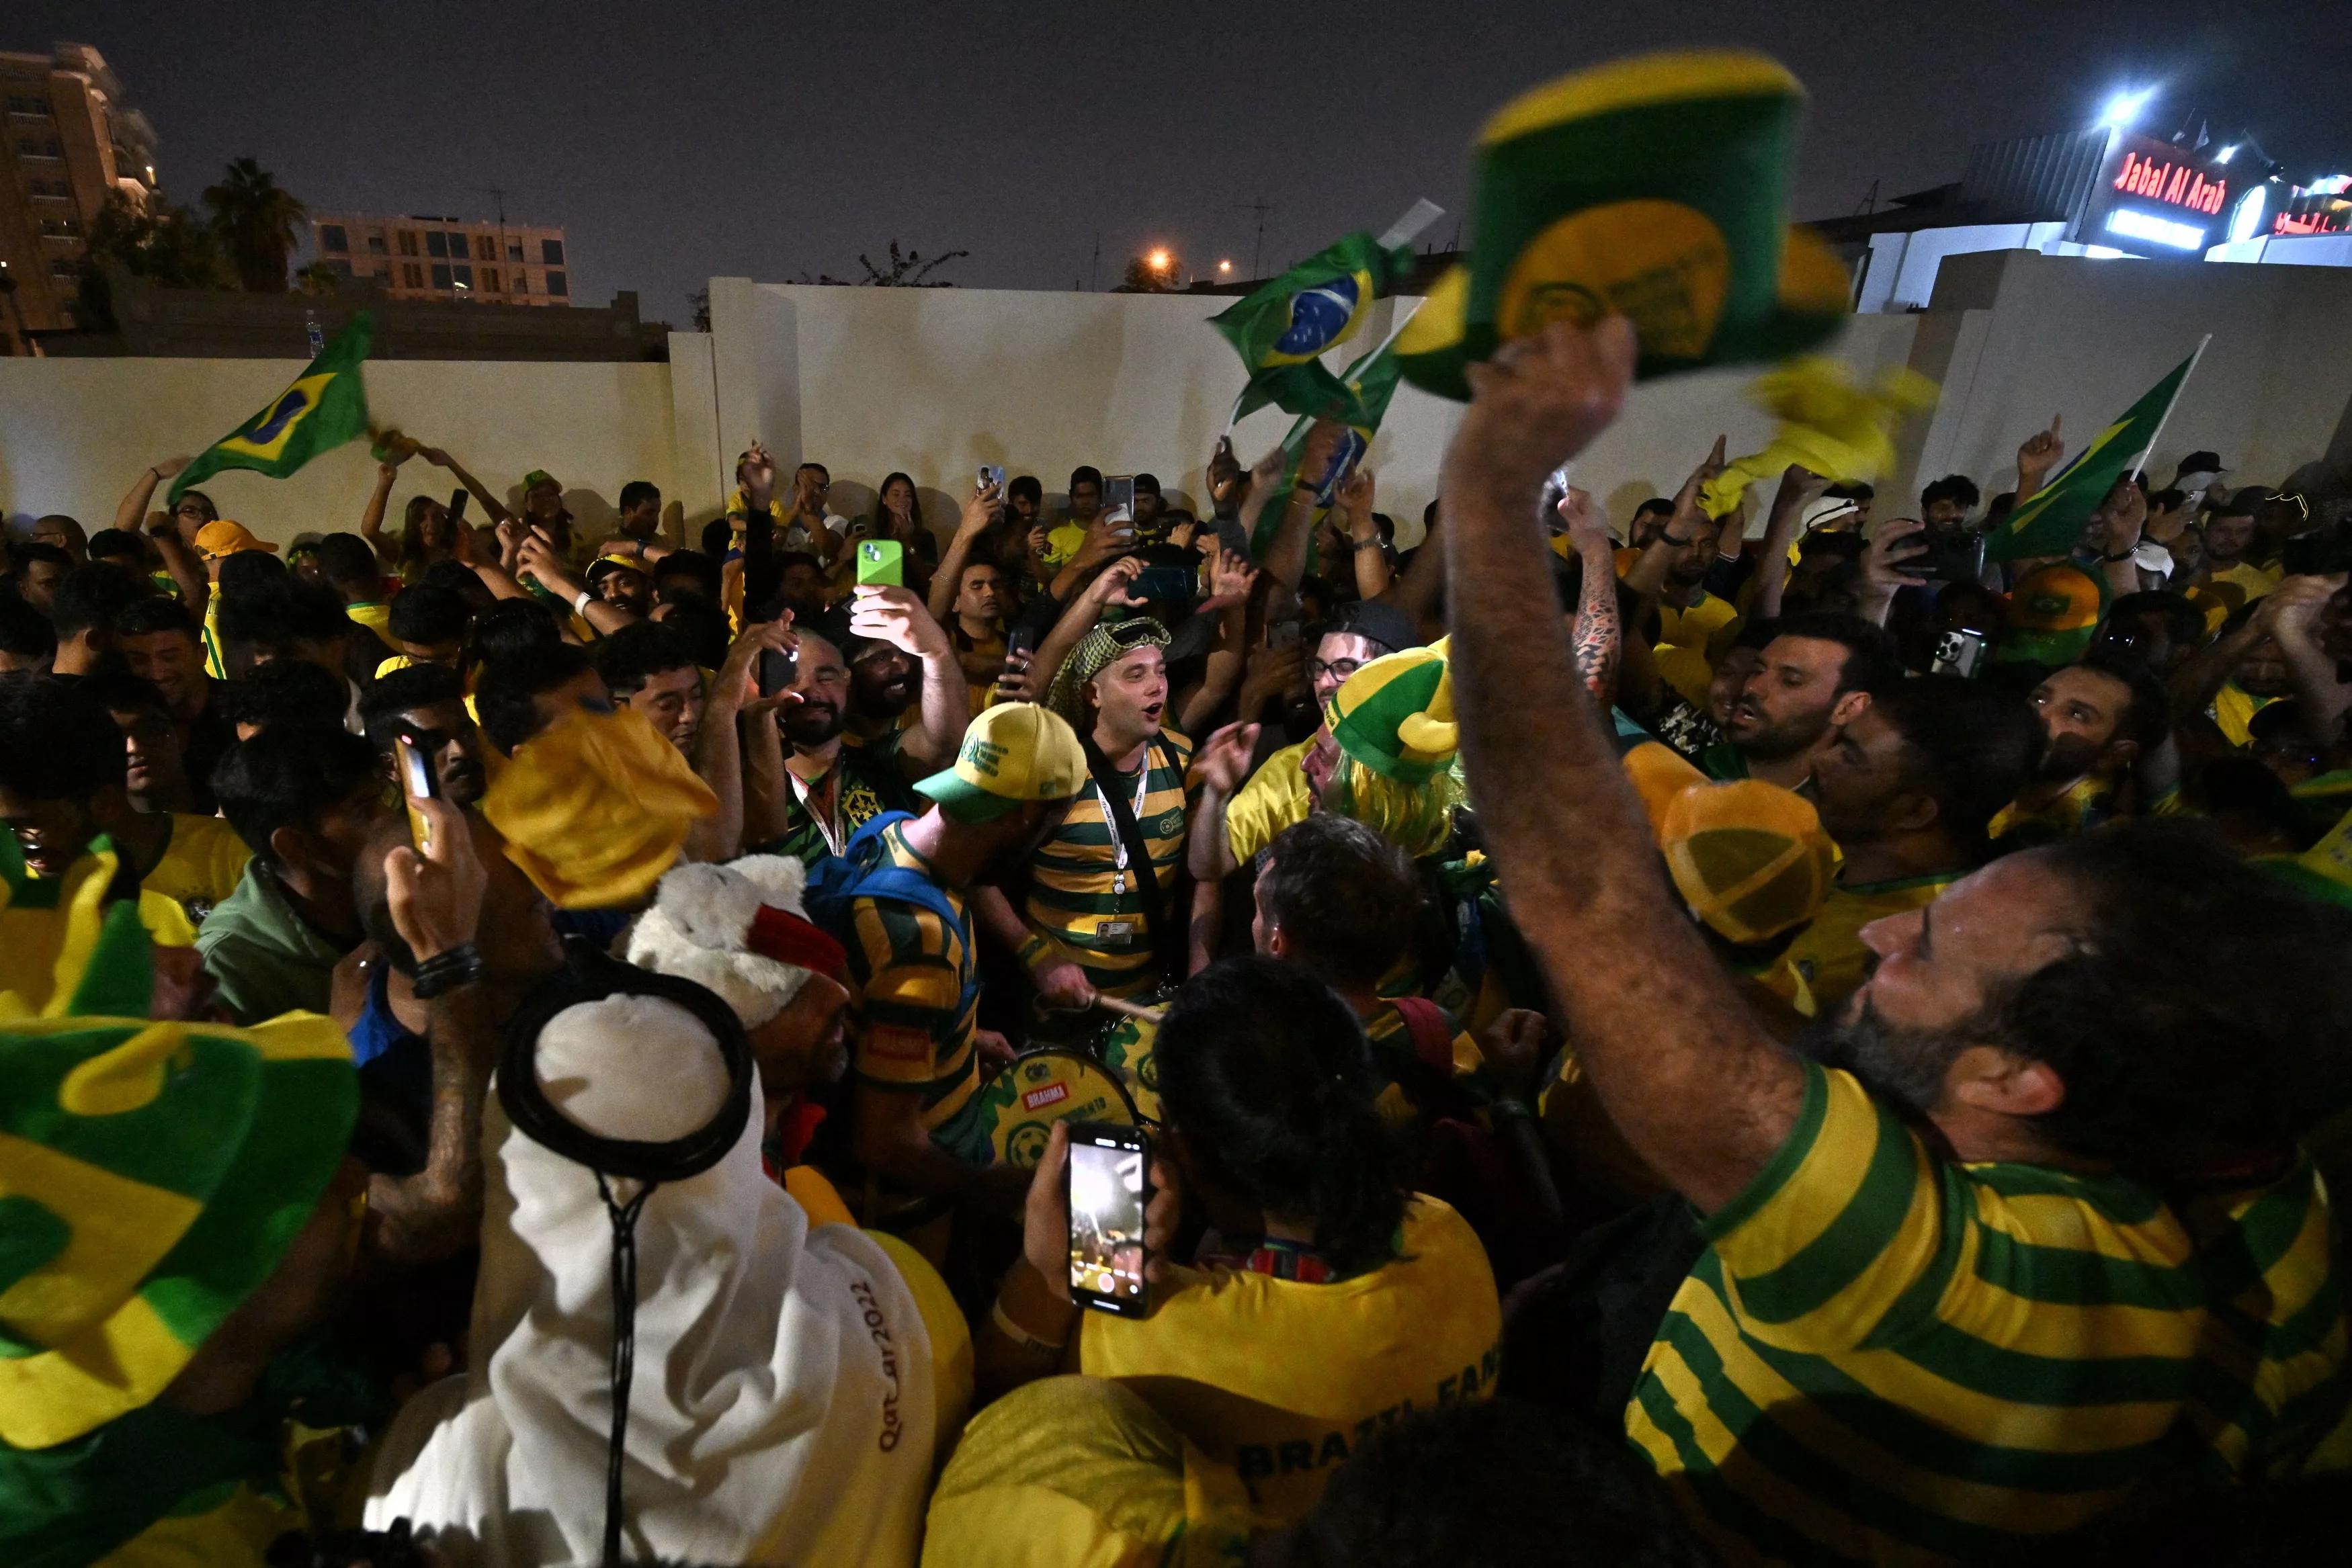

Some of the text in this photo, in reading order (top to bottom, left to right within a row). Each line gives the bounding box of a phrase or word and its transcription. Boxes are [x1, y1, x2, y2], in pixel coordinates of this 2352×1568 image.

[2115, 152, 2226, 214] Jabal Al Arab
[1026, 1084, 1066, 1109] BRAHMA
